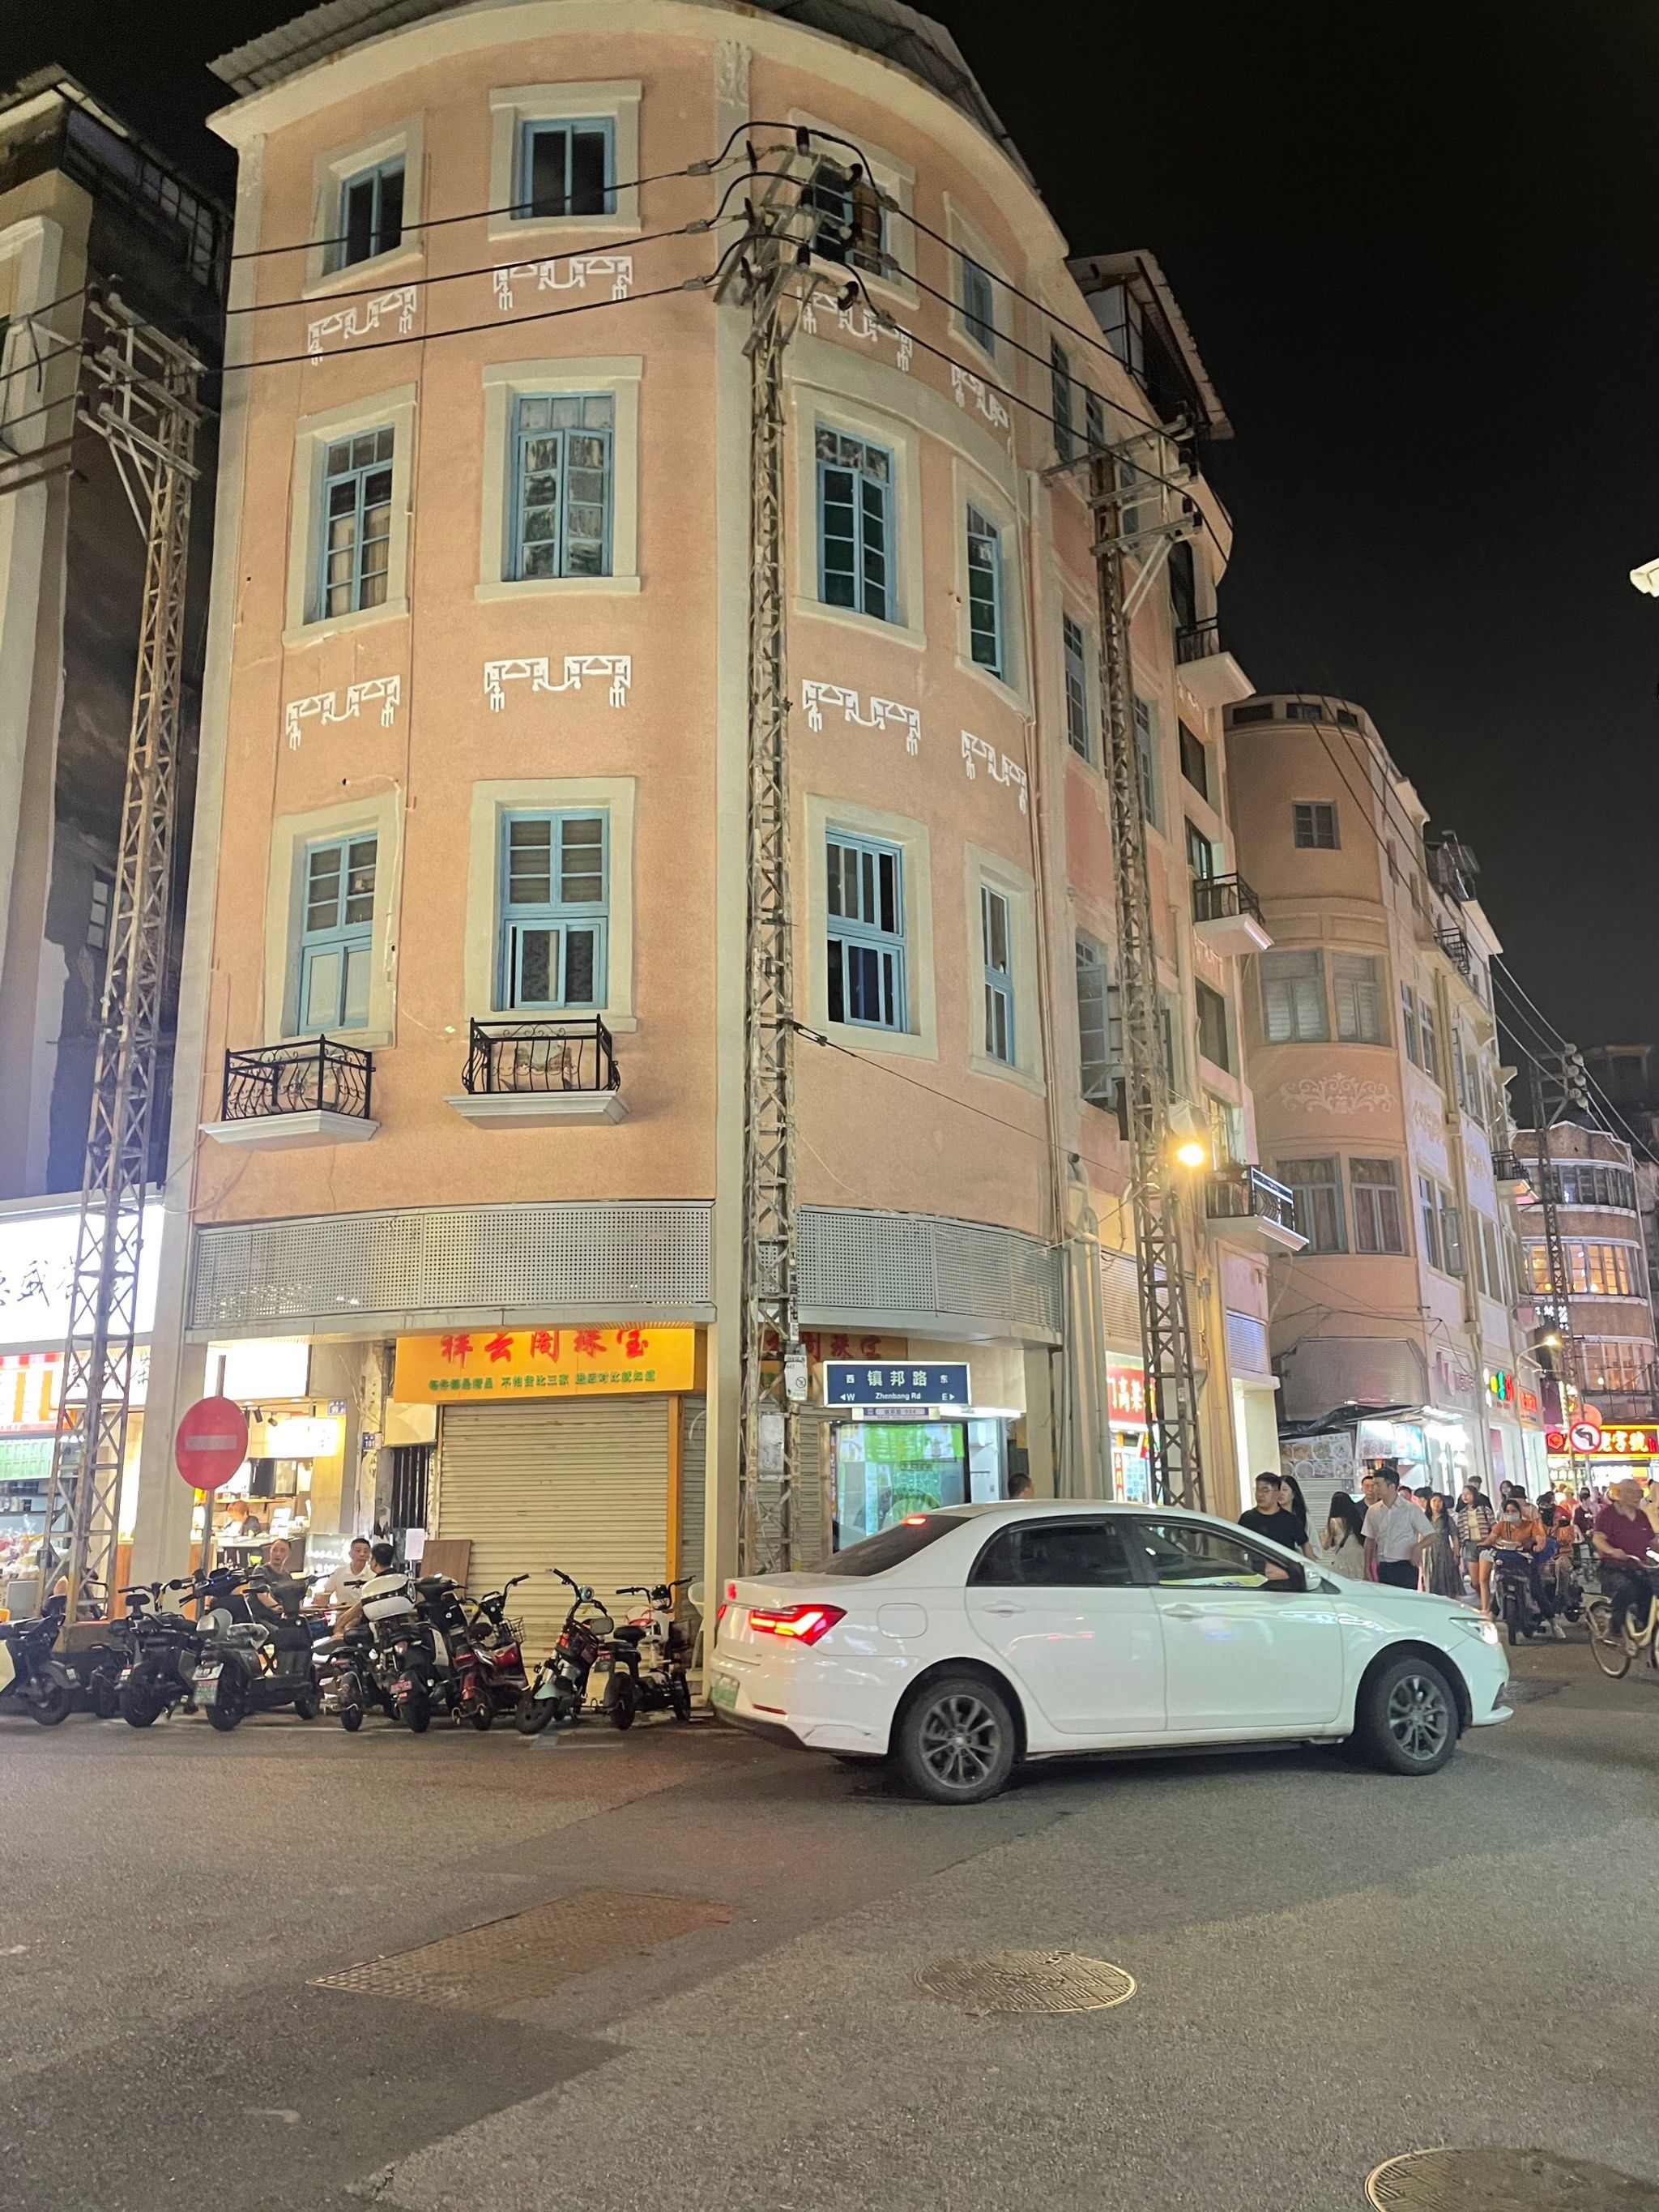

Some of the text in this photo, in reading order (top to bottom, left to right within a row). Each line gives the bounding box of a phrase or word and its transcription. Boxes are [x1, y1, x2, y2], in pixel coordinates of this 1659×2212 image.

[501, 1374, 569, 1388] 不怕货比三家
[846, 1370, 949, 1387] 西 镇邦路 东
[847, 1392, 948, 1401] W Zhenbang Rd E
